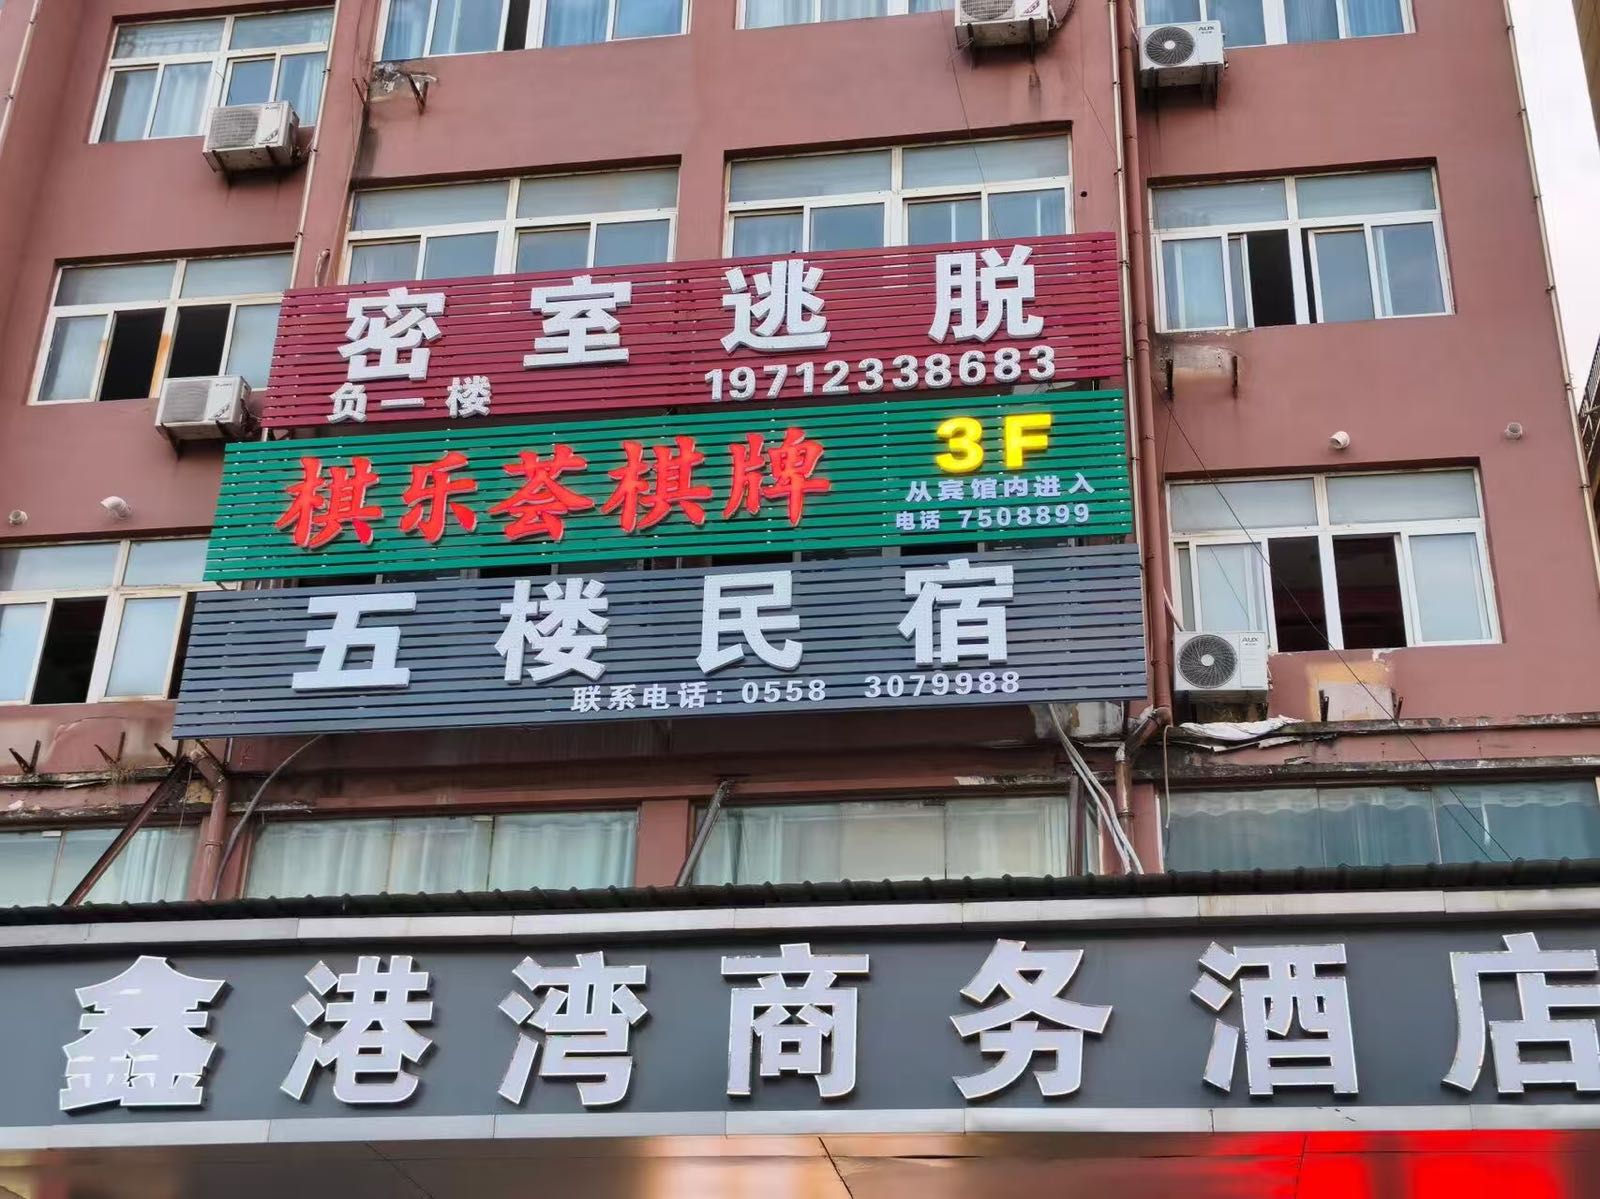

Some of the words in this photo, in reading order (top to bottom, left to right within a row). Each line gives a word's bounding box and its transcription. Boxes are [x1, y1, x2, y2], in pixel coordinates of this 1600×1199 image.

[337, 244, 1044, 382] 密室逃脱
[327, 375, 493, 424] 负一楼
[704, 345, 1056, 401] 19712338683
[935, 413, 1053, 474] 3F
[275, 427, 832, 551] 棋乐荟棋牌
[905, 471, 1095, 504] 从宾馆内进入
[895, 509, 941, 533] 电话
[957, 503, 1090, 530] 7508899
[291, 558, 1015, 693] 五楼民宿
[741, 679, 827, 704] 0558
[864, 670, 1021, 699] 3079988
[58, 931, 1600, 1113] 鑫港湾商务酒店
